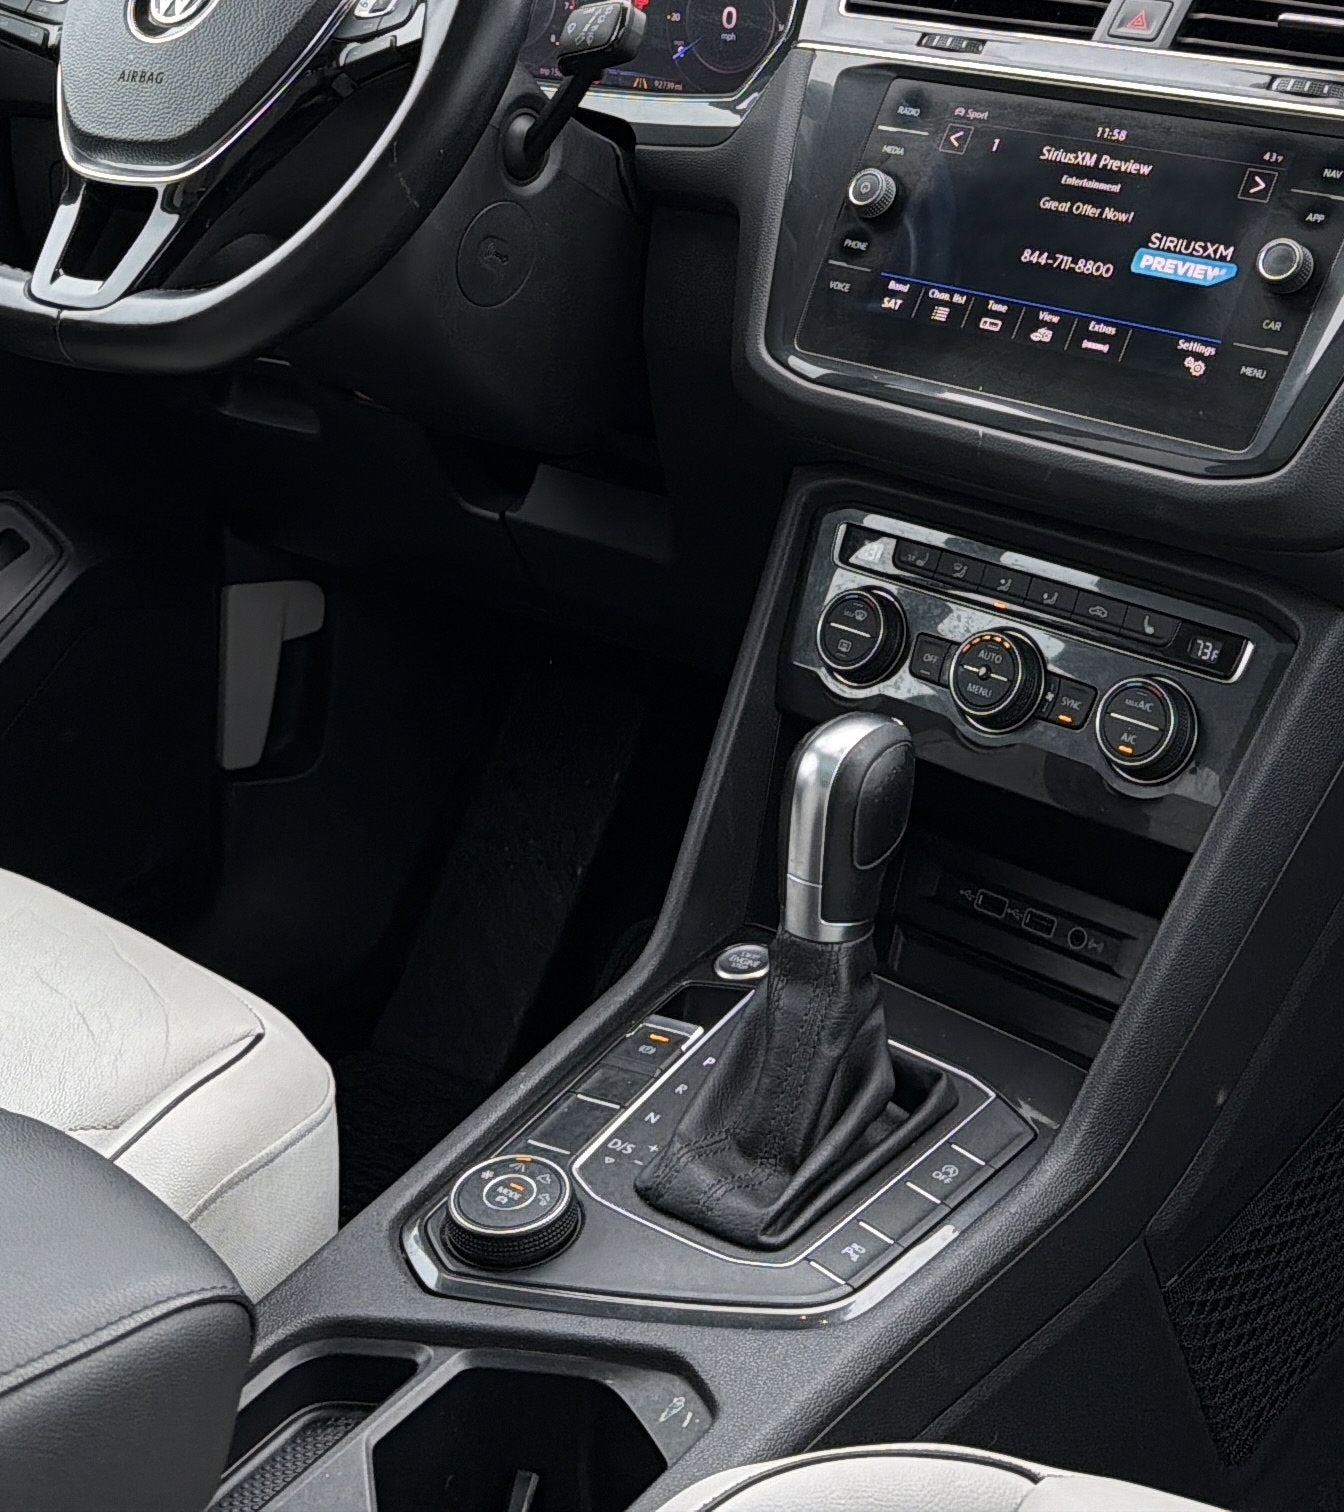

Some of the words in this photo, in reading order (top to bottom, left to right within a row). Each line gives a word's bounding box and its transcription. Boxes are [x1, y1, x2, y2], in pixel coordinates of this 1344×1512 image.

[721, 6, 738, 30] 0
[118, 71, 165, 85] AIRBAG
[897, 105, 921, 118] RADIO
[966, 108, 990, 122] Sport
[1096, 126, 1128, 142] 11:58
[882, 144, 905, 156] MEDIA
[990, 137, 1000, 153] 1
[1039, 145, 1097, 168] SiriusXM
[1099, 153, 1154, 177] Preview
[1322, 168, 1344, 180] NAV
[1060, 174, 1122, 194] Entertainment
[1039, 196, 1070, 213] Great
[1072, 201, 1100, 219] Offer
[1101, 205, 1135, 224] Now!
[1305, 212, 1326, 224] APP
[843, 238, 869, 252] PHONE
[1147, 232, 1235, 261] SIRIUSXM
[1020, 247, 1114, 279] 844-711-8800
[1139, 254, 1219, 281] PREVIEW
[829, 280, 852, 293] VOICE
[887, 279, 910, 294] Band
[881, 296, 904, 312] SAT
[987, 299, 1009, 315] Tune
[1038, 309, 1061, 325] View
[1088, 320, 1117, 337] Extras
[1262, 319, 1282, 332] CAR
[1177, 337, 1217, 359] Settings
[1239, 365, 1267, 380] MENU
[922, 652, 939, 665] OFF
[978, 648, 1003, 665] AUTO
[966, 683, 993, 699] MENU
[1060, 696, 1083, 711] SYNC
[1120, 731, 1137, 745] A/C
[728, 954, 762, 968] ENGINE
[702, 1056, 716, 1067] P
[674, 1083, 689, 1095] R
[644, 1111, 662, 1125] N
[606, 1137, 636, 1155] D/S
[931, 1170, 954, 1184] OFF
[496, 1185, 523, 1201] MODE
